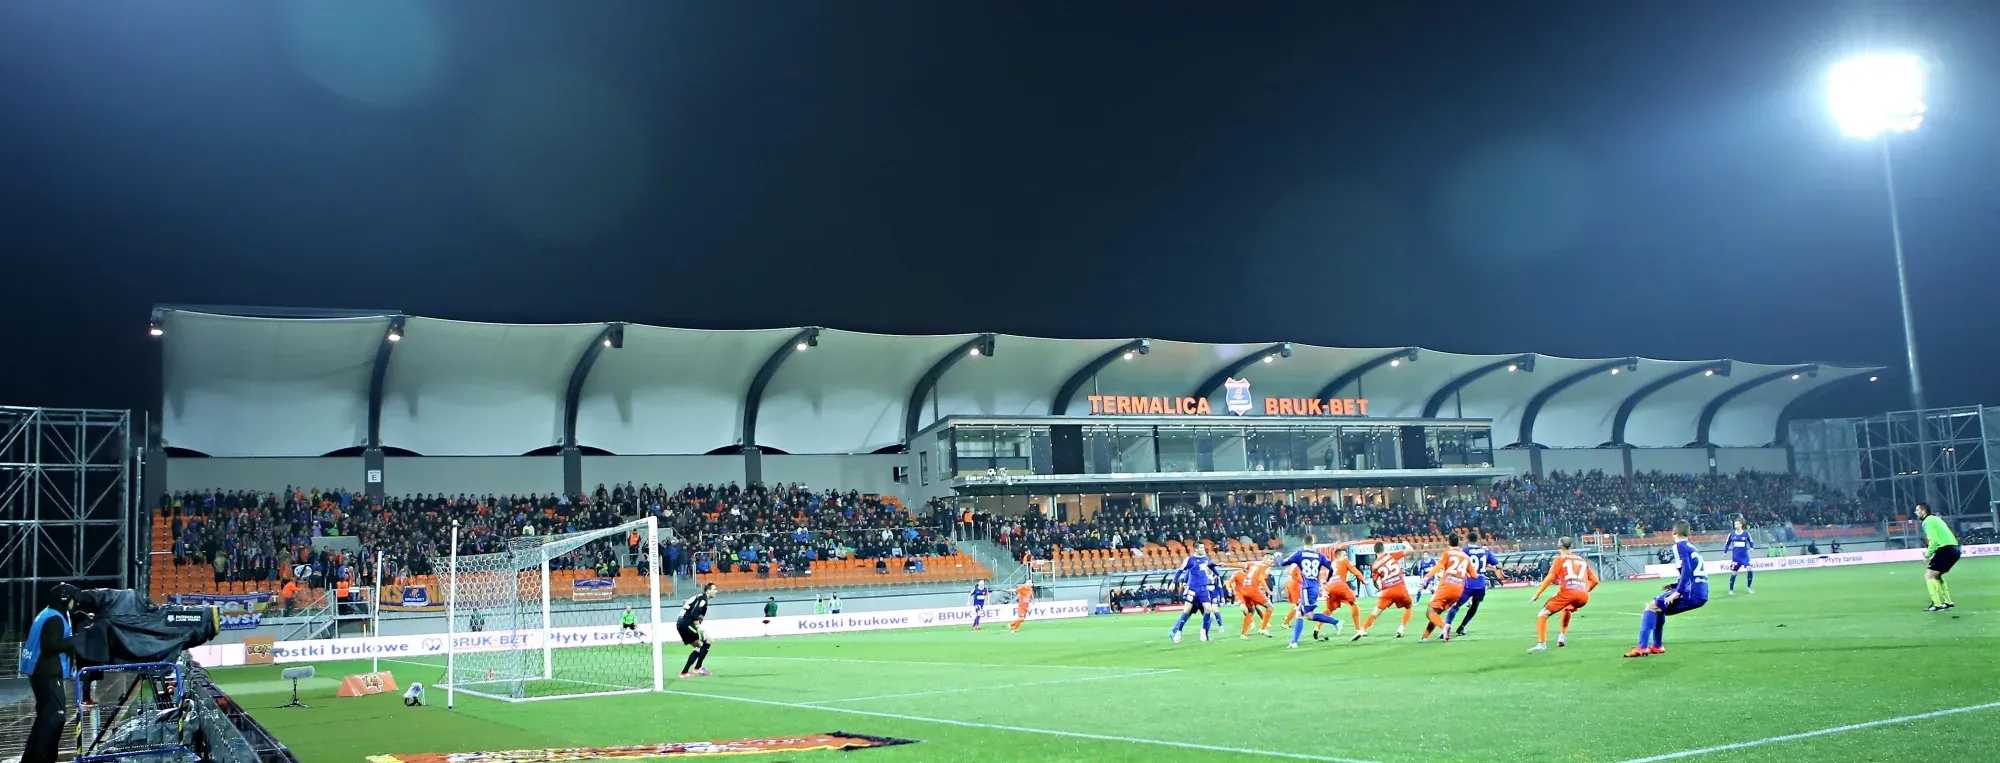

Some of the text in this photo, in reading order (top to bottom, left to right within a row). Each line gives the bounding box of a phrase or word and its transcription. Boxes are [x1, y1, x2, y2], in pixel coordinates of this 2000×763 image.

[1088, 395, 1369, 416] TERMALICA BRUK-BET
[1300, 558, 1321, 577] 88
[1377, 557, 1401, 582] 25
[1445, 555, 1469, 578] 24
[1468, 554, 1487, 573] 91
[1562, 559, 1587, 581] 17
[799, 616, 844, 630] Kostki
[848, 615, 909, 628] brukowe
[1012, 606, 1046, 618] Pyty
[332, 643, 409, 656] brukowe
